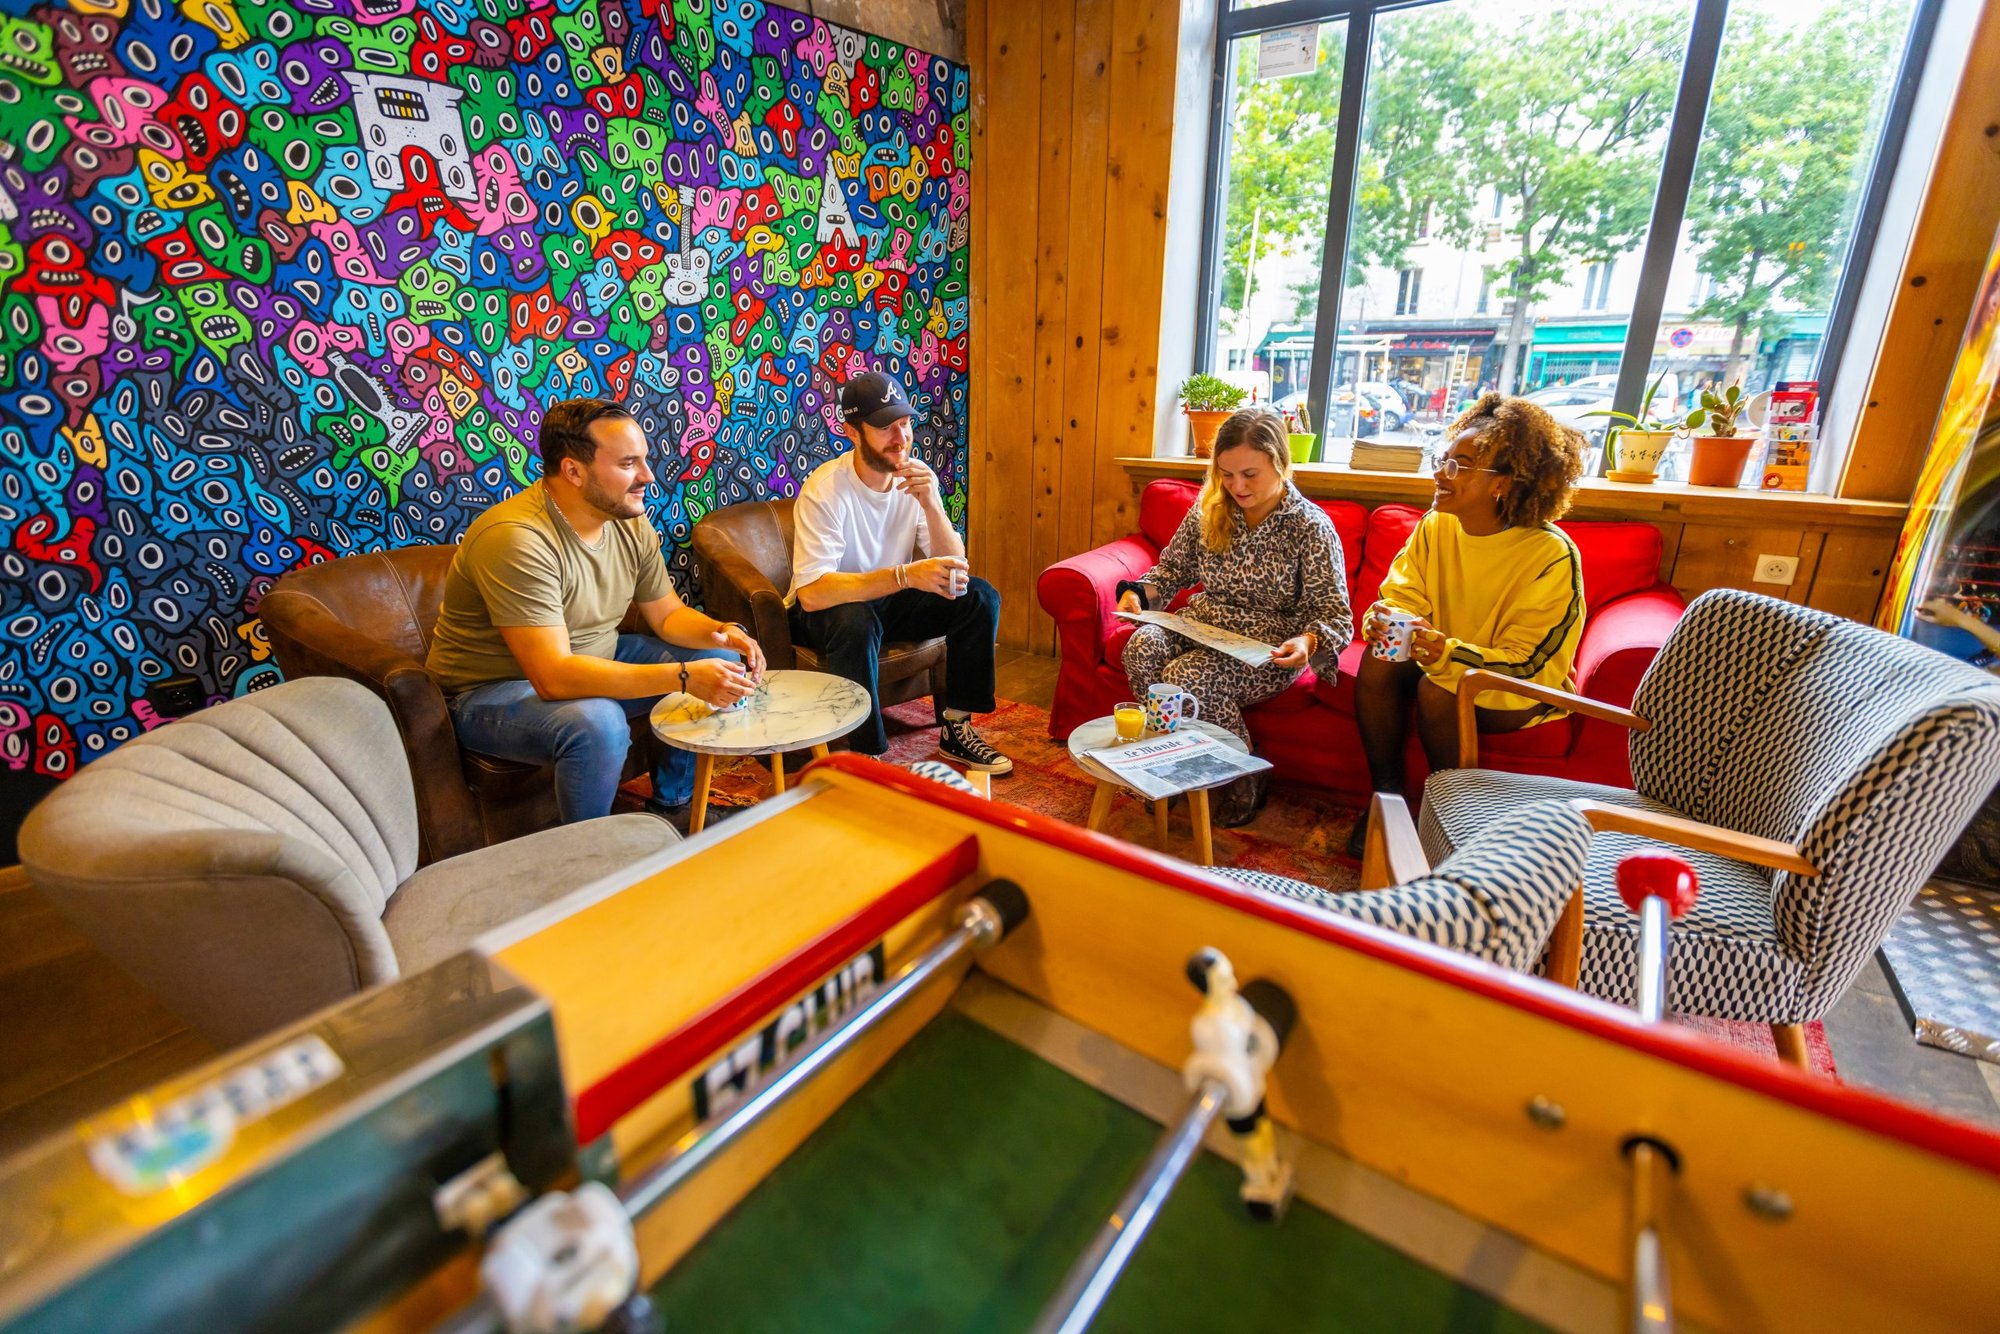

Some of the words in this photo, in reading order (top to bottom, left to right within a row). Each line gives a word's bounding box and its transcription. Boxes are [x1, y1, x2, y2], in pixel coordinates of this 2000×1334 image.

[880, 381, 902, 403] A
[1124, 750, 1138, 758] Le
[1138, 740, 1184, 755] Monde
